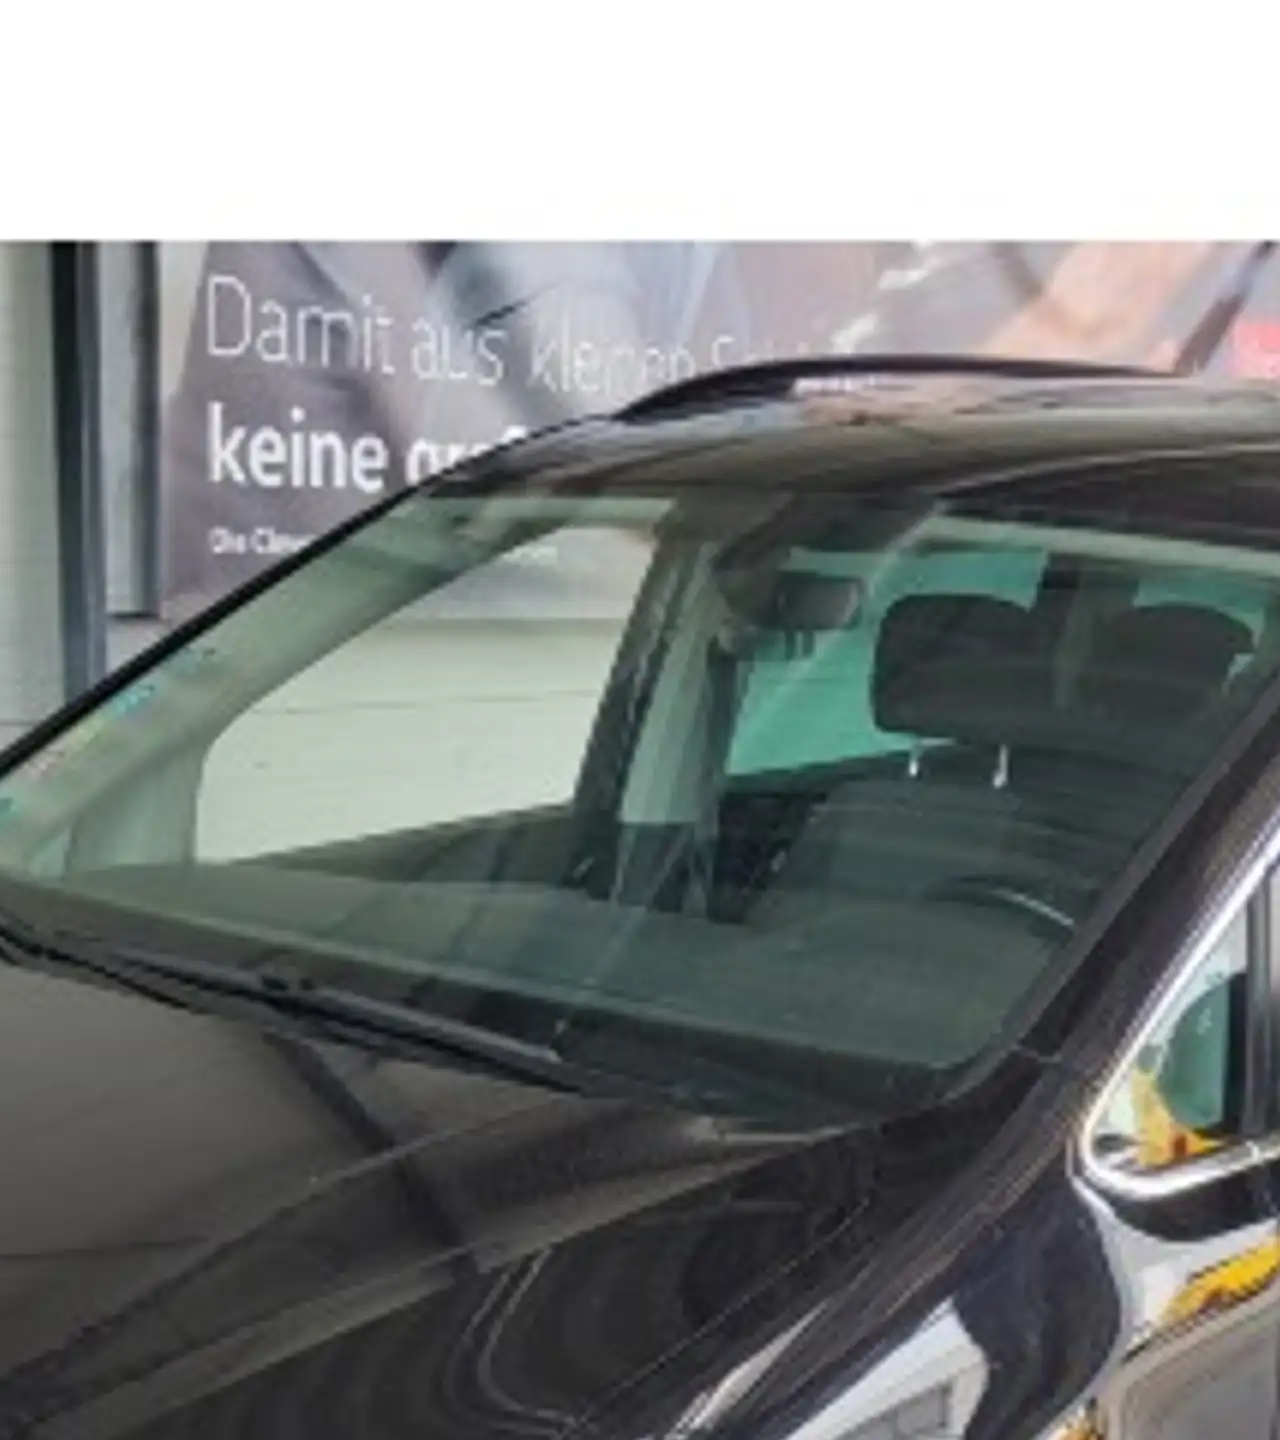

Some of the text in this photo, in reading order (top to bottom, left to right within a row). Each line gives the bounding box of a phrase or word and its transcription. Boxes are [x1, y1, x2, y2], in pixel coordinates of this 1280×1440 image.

[206, 275, 395, 376] Damit
[410, 317, 506, 386] aus
[208, 400, 389, 494] keine
